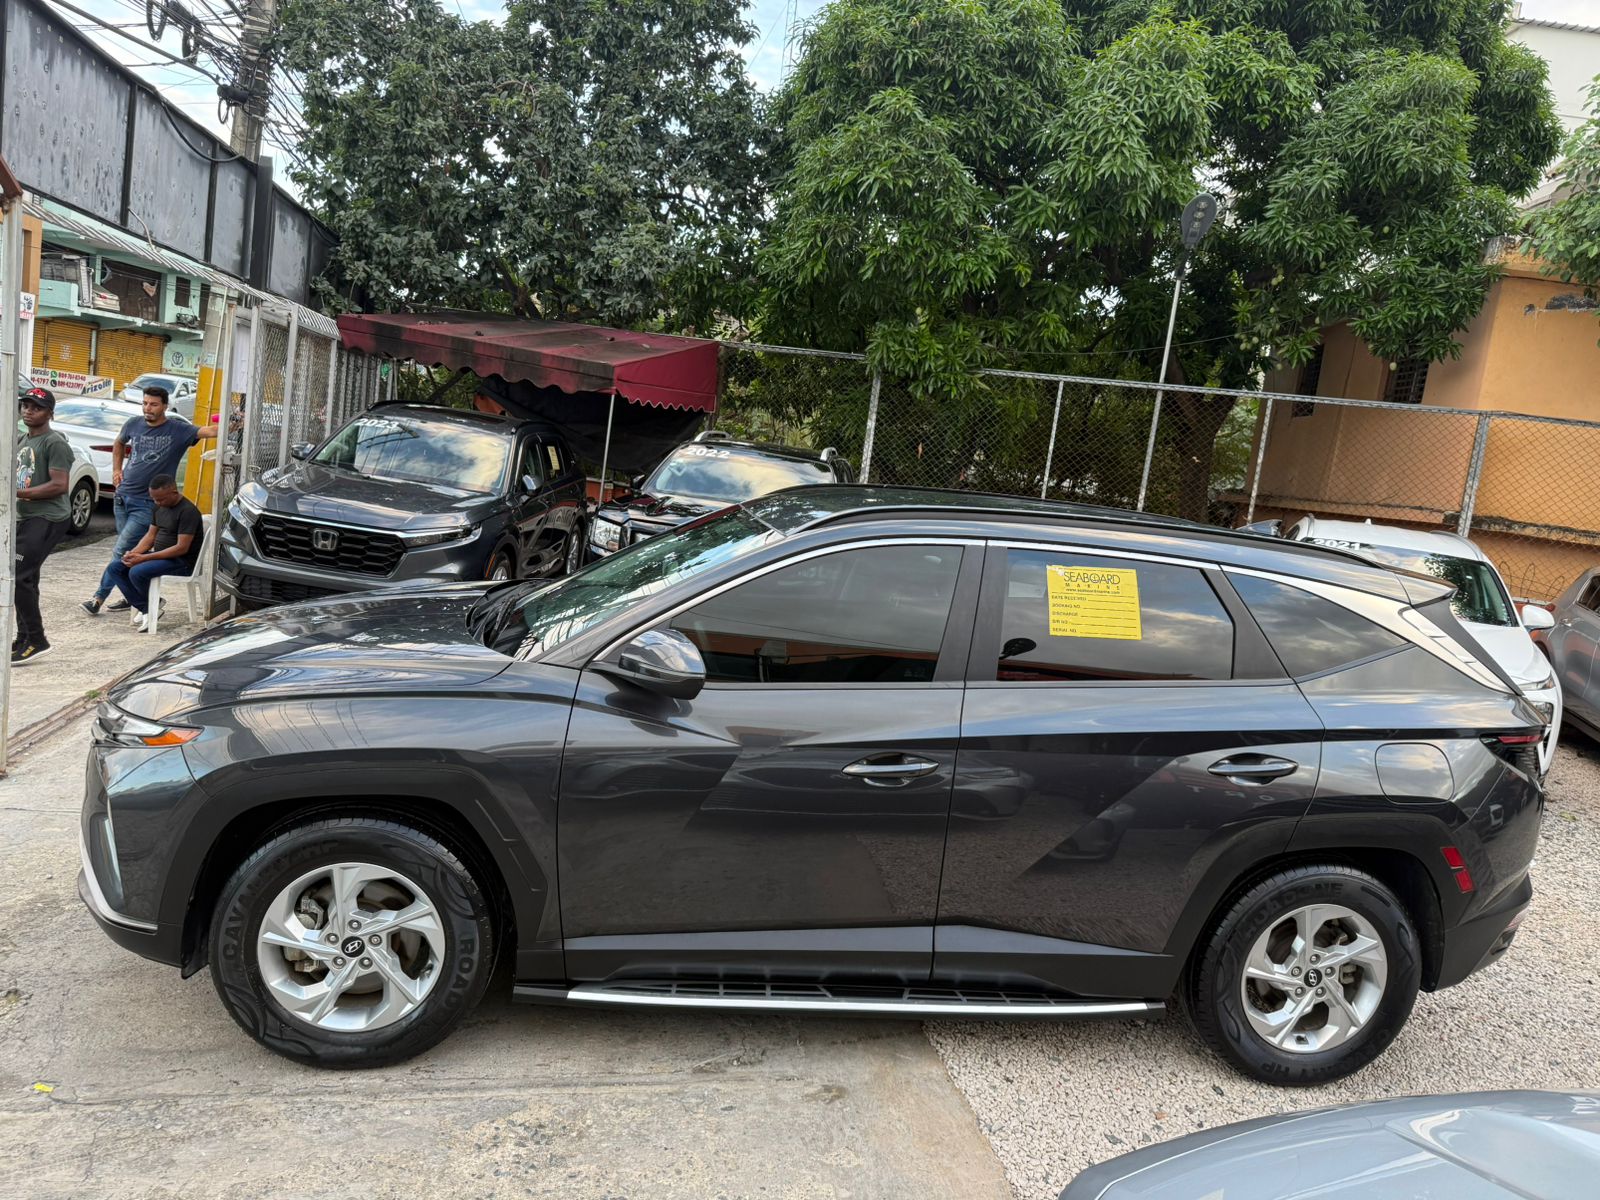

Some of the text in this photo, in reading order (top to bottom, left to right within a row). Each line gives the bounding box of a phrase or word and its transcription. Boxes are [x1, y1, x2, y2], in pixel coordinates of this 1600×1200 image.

[687, 447, 730, 459] 2022
[1313, 538, 1361, 551] 2021
[1063, 571, 1121, 585] SEABOARD
